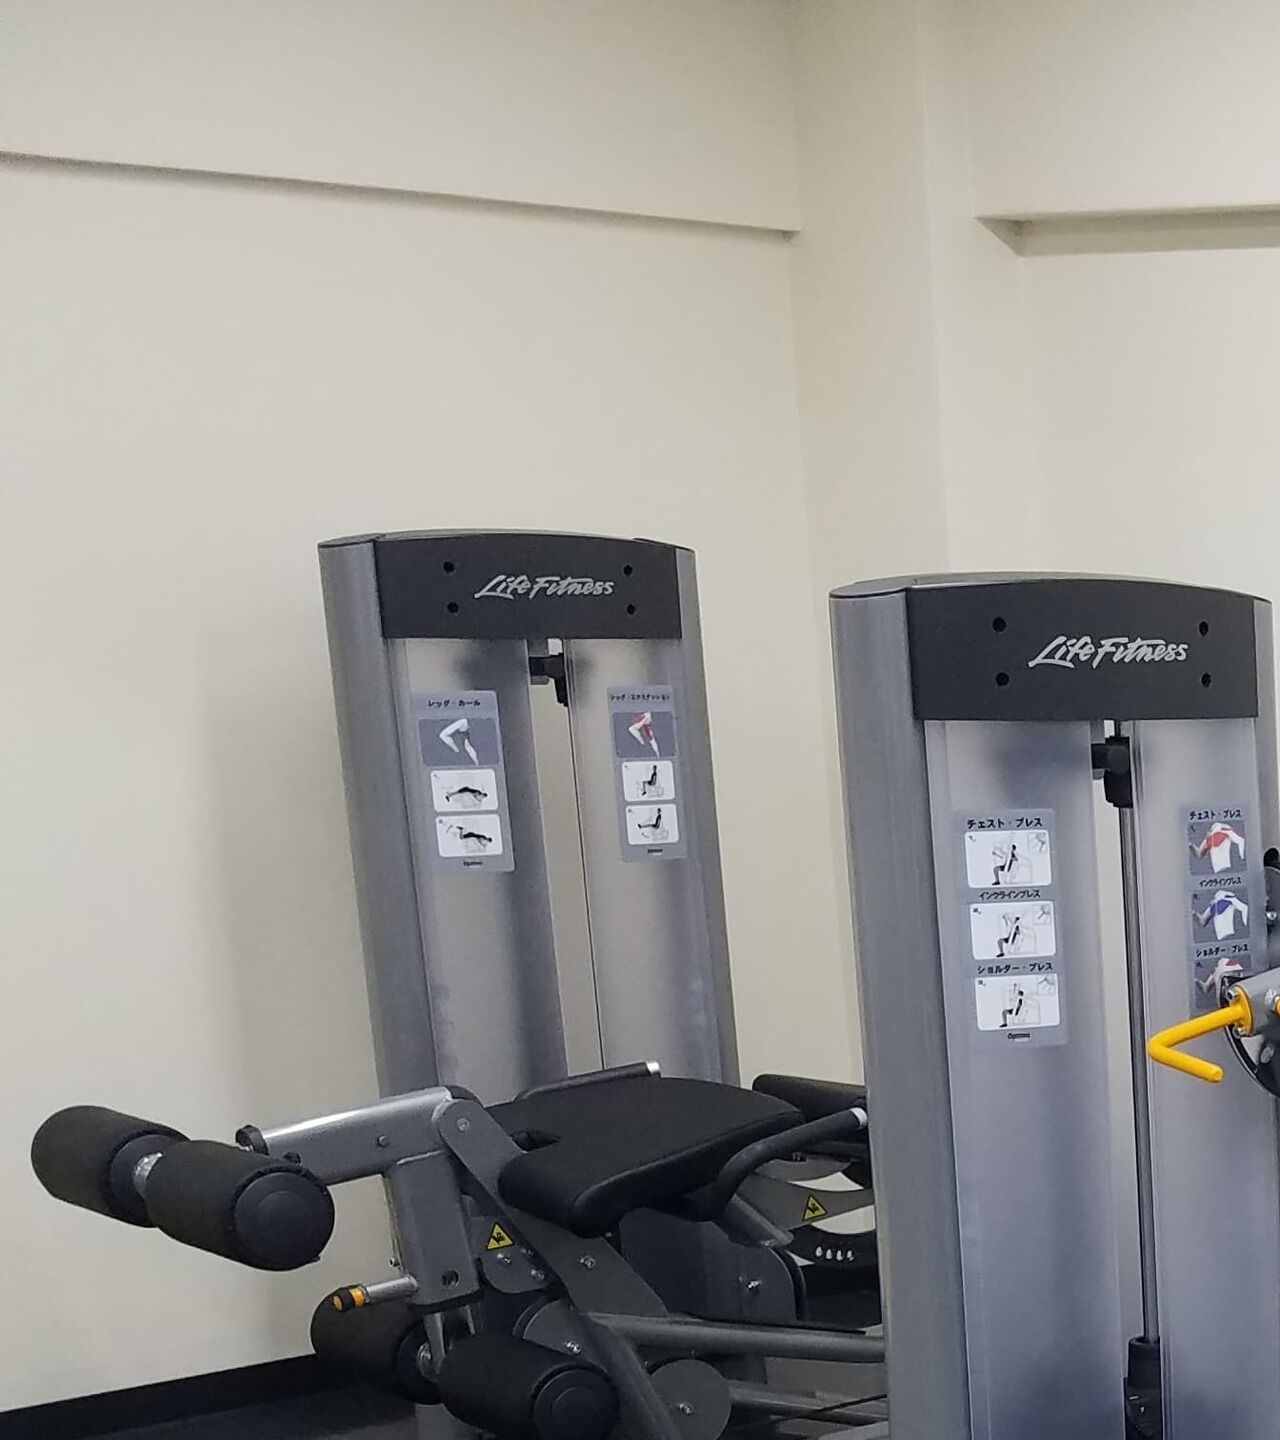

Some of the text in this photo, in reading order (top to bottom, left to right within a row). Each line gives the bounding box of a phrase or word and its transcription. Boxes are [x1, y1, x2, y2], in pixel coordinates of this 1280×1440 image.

[473, 574, 615, 600] Life Fitness
[1027, 635, 1189, 669] Life Fitness
